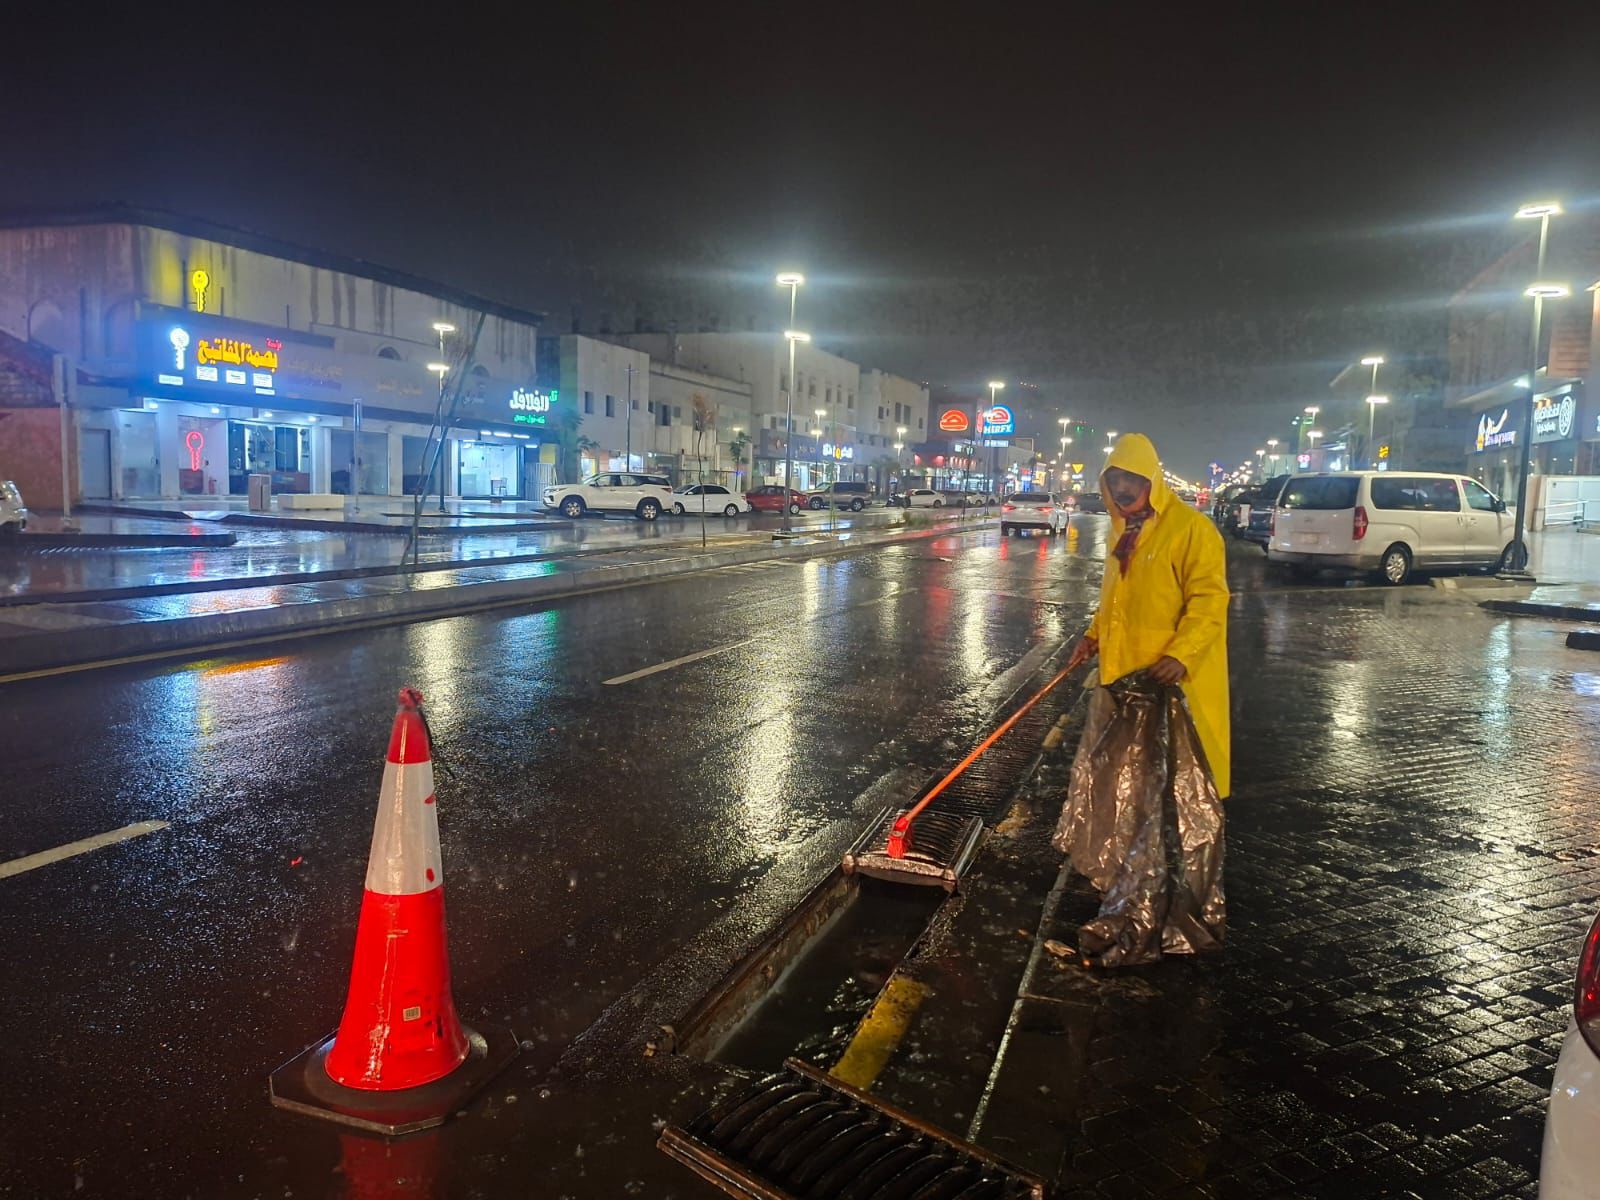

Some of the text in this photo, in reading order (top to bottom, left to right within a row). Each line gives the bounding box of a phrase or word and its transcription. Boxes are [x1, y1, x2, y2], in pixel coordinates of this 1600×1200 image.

[197, 338, 245, 365] المفاتيح
[246, 345, 279, 373] بصمة
[509, 387, 550, 412] الفلافل
